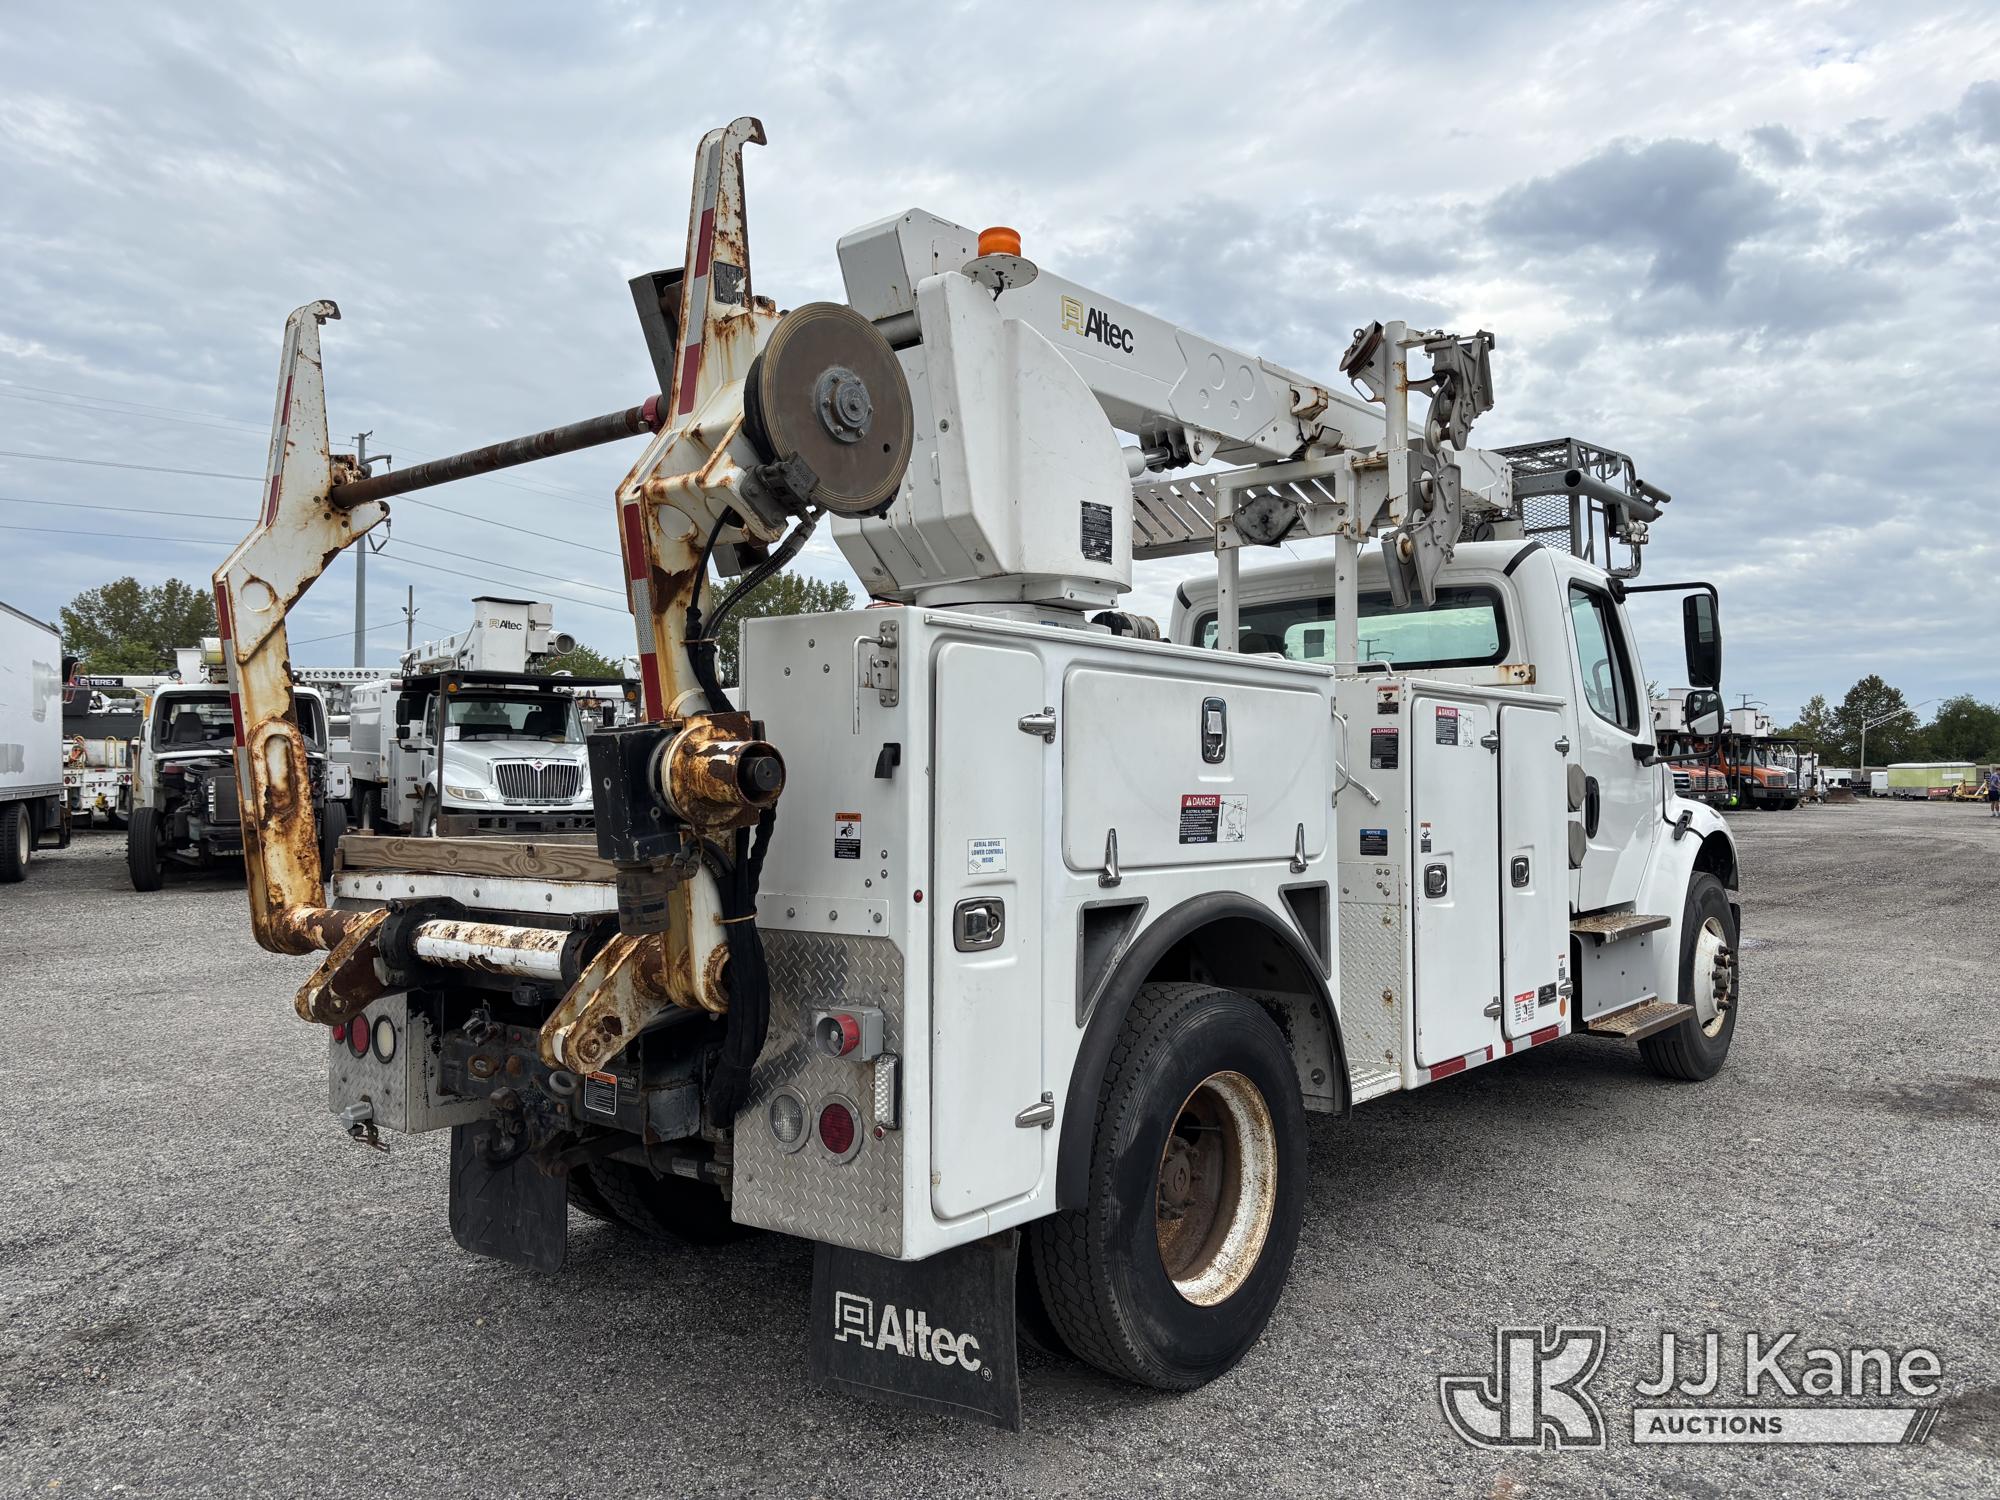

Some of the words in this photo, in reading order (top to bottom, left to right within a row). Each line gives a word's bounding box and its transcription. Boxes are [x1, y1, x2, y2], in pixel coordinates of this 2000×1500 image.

[1084, 307, 1134, 354] Altec
[500, 620, 522, 630] Altec
[1442, 708, 1456, 717] DANGER
[1192, 797, 1216, 807] DANGER
[876, 1304, 981, 1372] Altec
